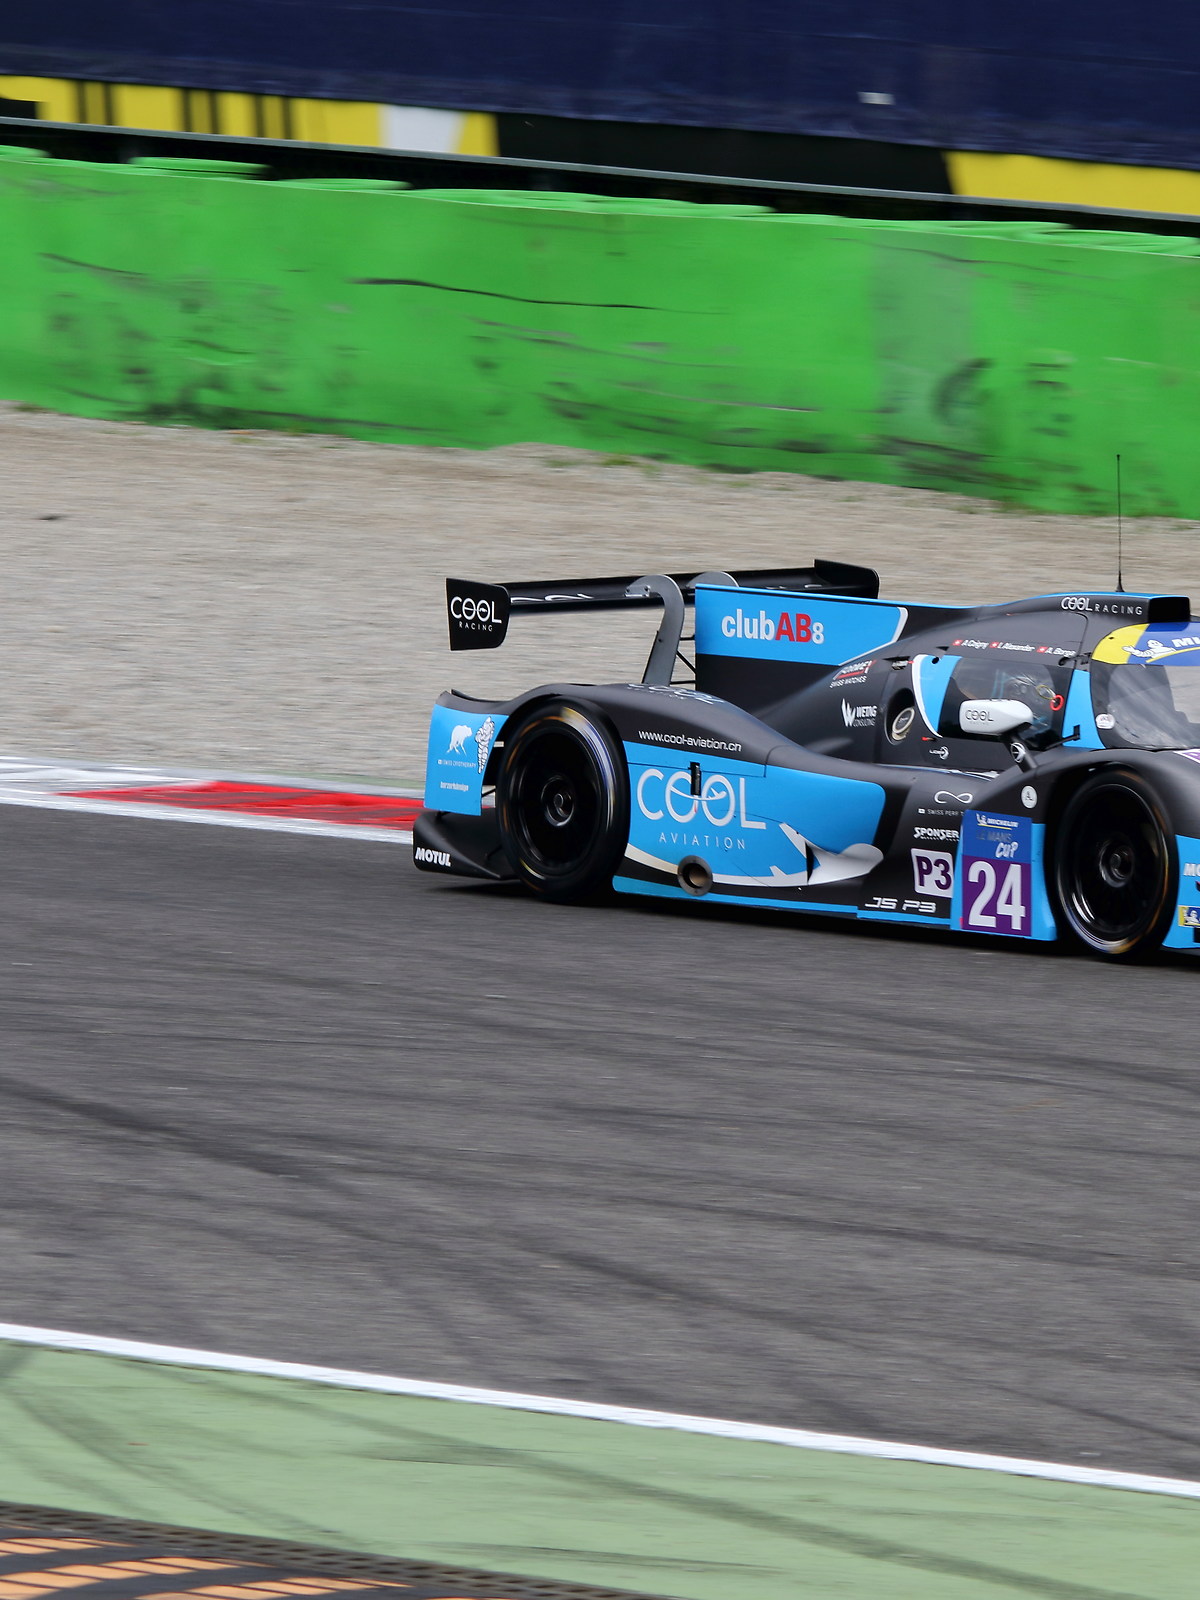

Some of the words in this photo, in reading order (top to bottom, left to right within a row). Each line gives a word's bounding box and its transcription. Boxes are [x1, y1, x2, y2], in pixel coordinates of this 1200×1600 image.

[450, 596, 502, 624] COOL
[1061, 597, 1093, 612] COOL
[1094, 603, 1143, 616] RACING
[458, 620, 493, 632] RACING
[965, 709, 994, 722] COOL
[638, 730, 742, 752] www.cool-aviation.cn
[637, 768, 767, 830] COOL
[659, 832, 746, 850] AVIATION
[913, 826, 960, 841] SPONSER
[414, 847, 452, 867] MOTUL
[915, 855, 952, 890] P3
[864, 896, 898, 910] JS
[902, 899, 937, 913] P3
[968, 860, 1026, 931] 24
